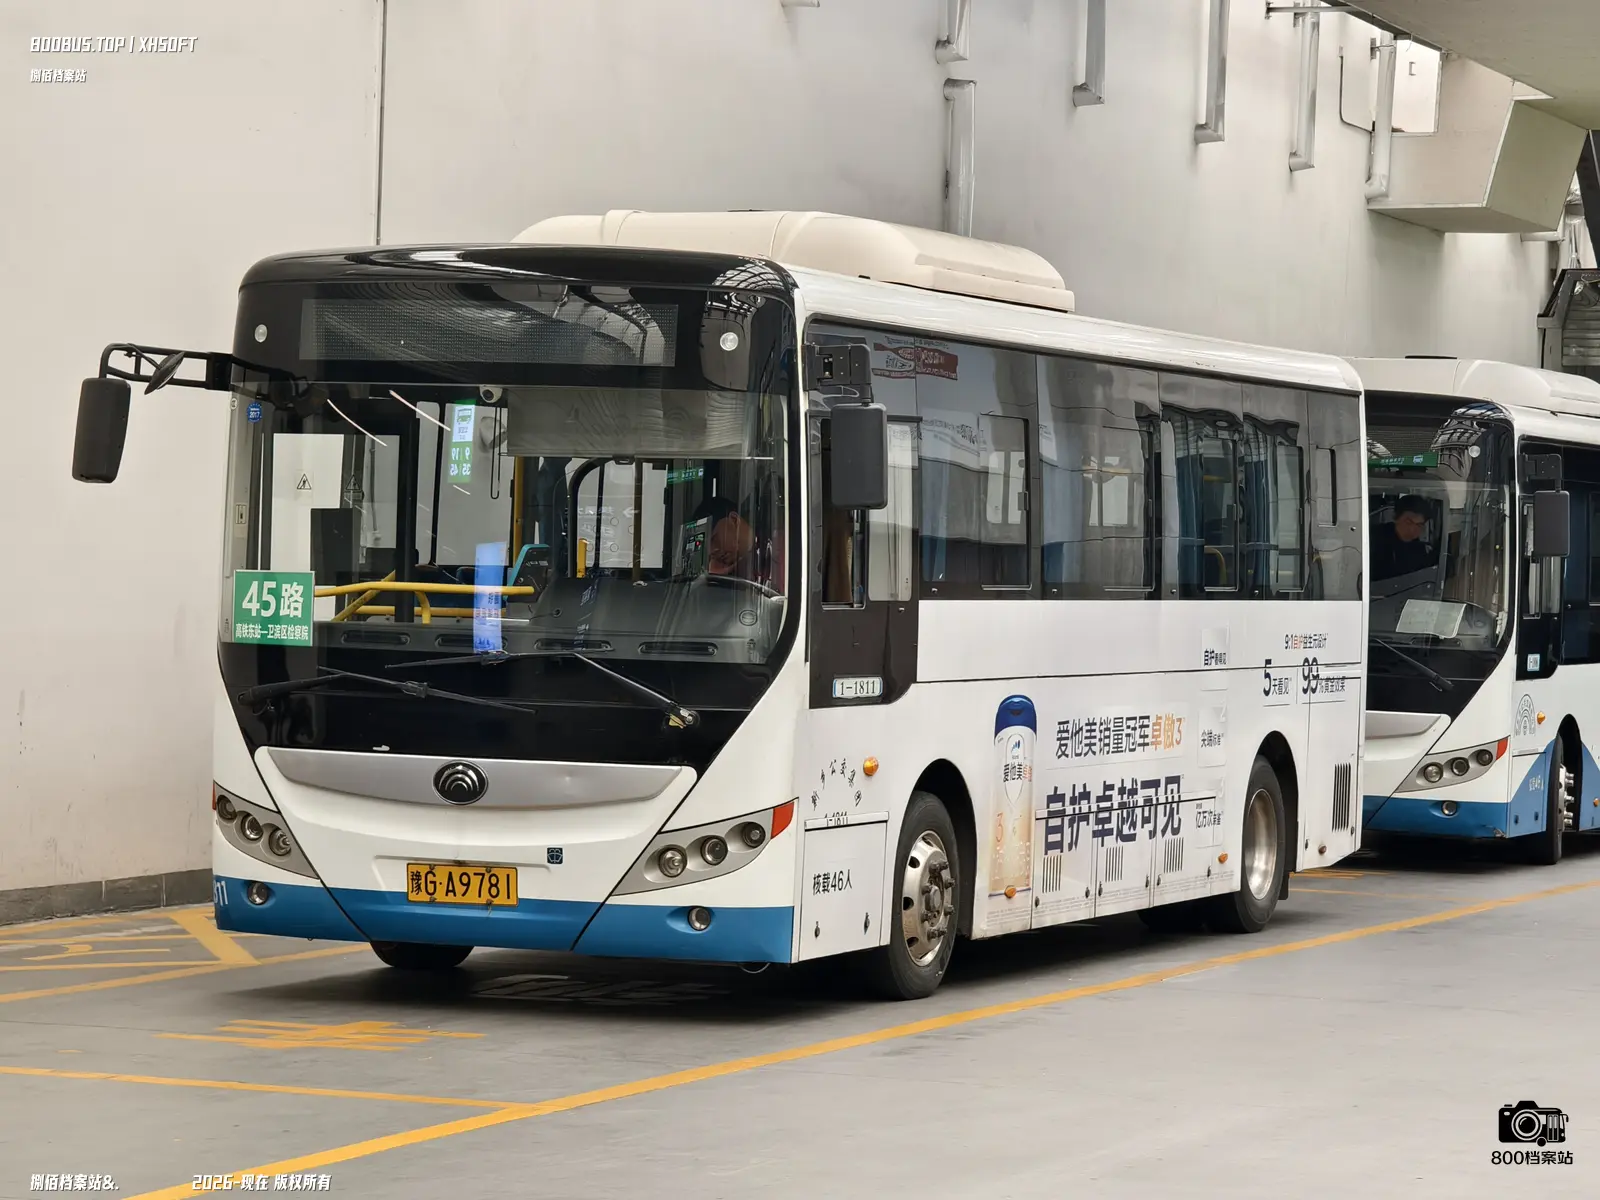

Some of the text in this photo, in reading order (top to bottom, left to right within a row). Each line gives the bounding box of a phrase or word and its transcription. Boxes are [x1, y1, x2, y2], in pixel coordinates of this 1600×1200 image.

[241, 580, 304, 618] 45路
[840, 680, 876, 695] 1-1811
[1043, 774, 1183, 856] 自护卓越可见
[812, 868, 853, 896] 核载46人
